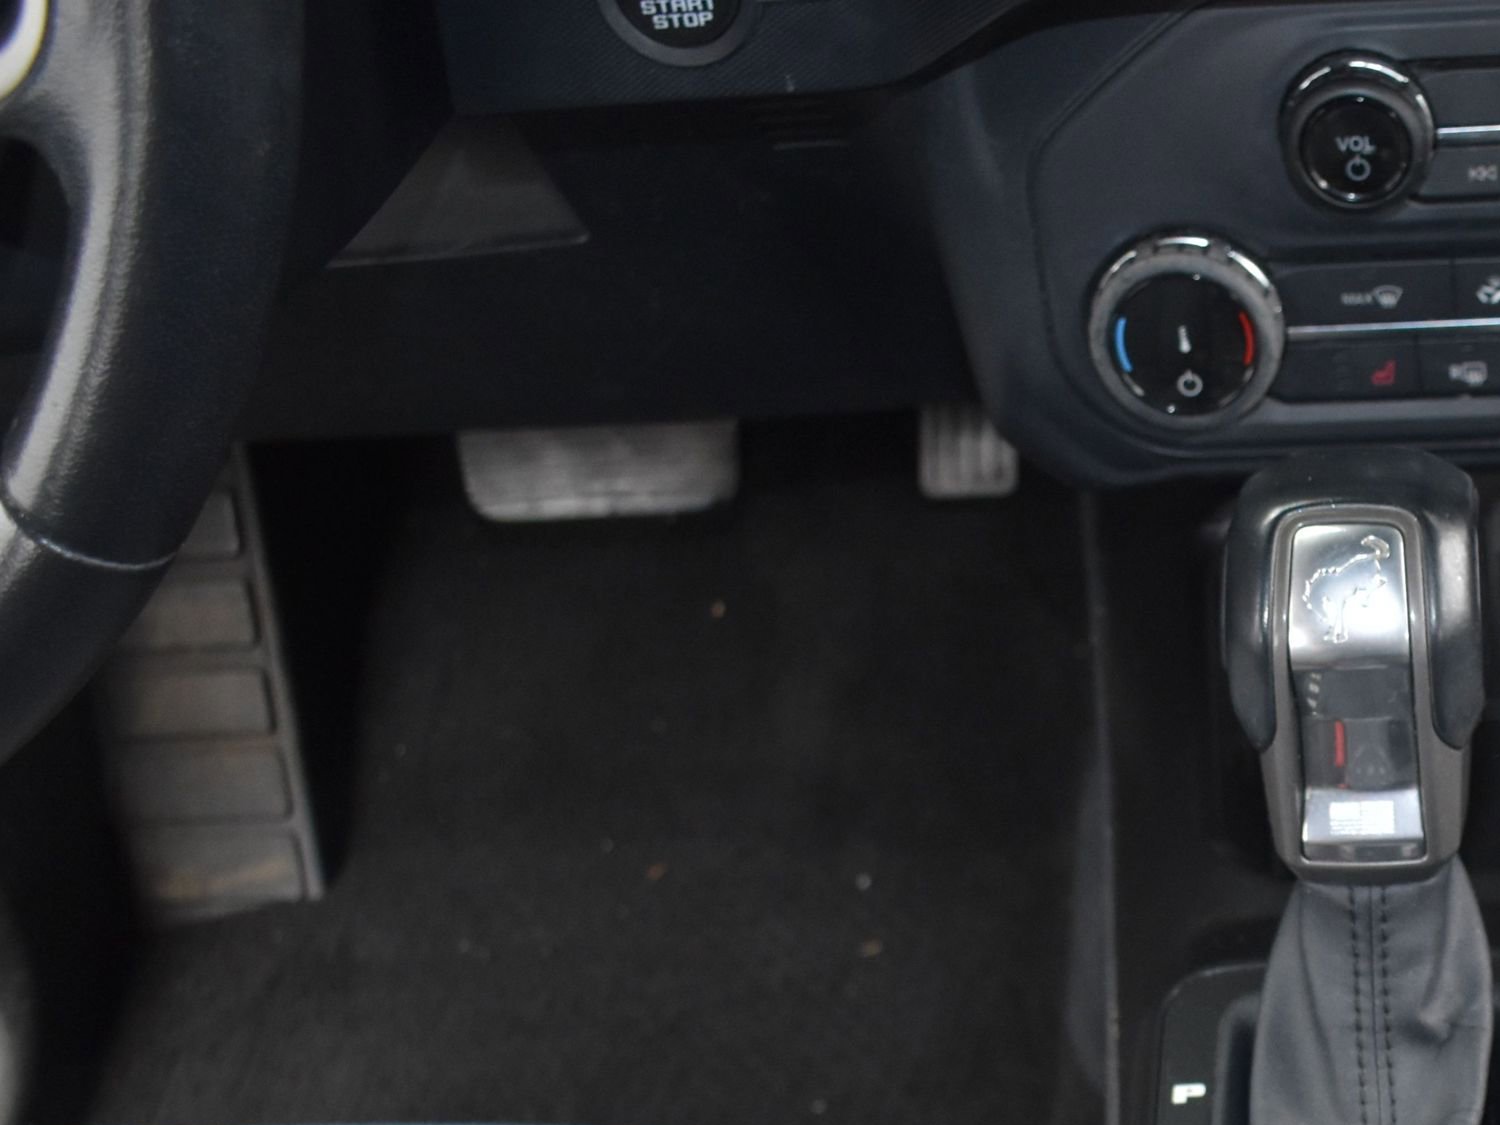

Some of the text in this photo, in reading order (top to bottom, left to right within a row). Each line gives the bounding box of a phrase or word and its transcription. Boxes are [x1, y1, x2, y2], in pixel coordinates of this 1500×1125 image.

[652, 11, 714, 30] STOP
[1335, 135, 1376, 154] VOL
[1171, 1083, 1206, 1104] P
